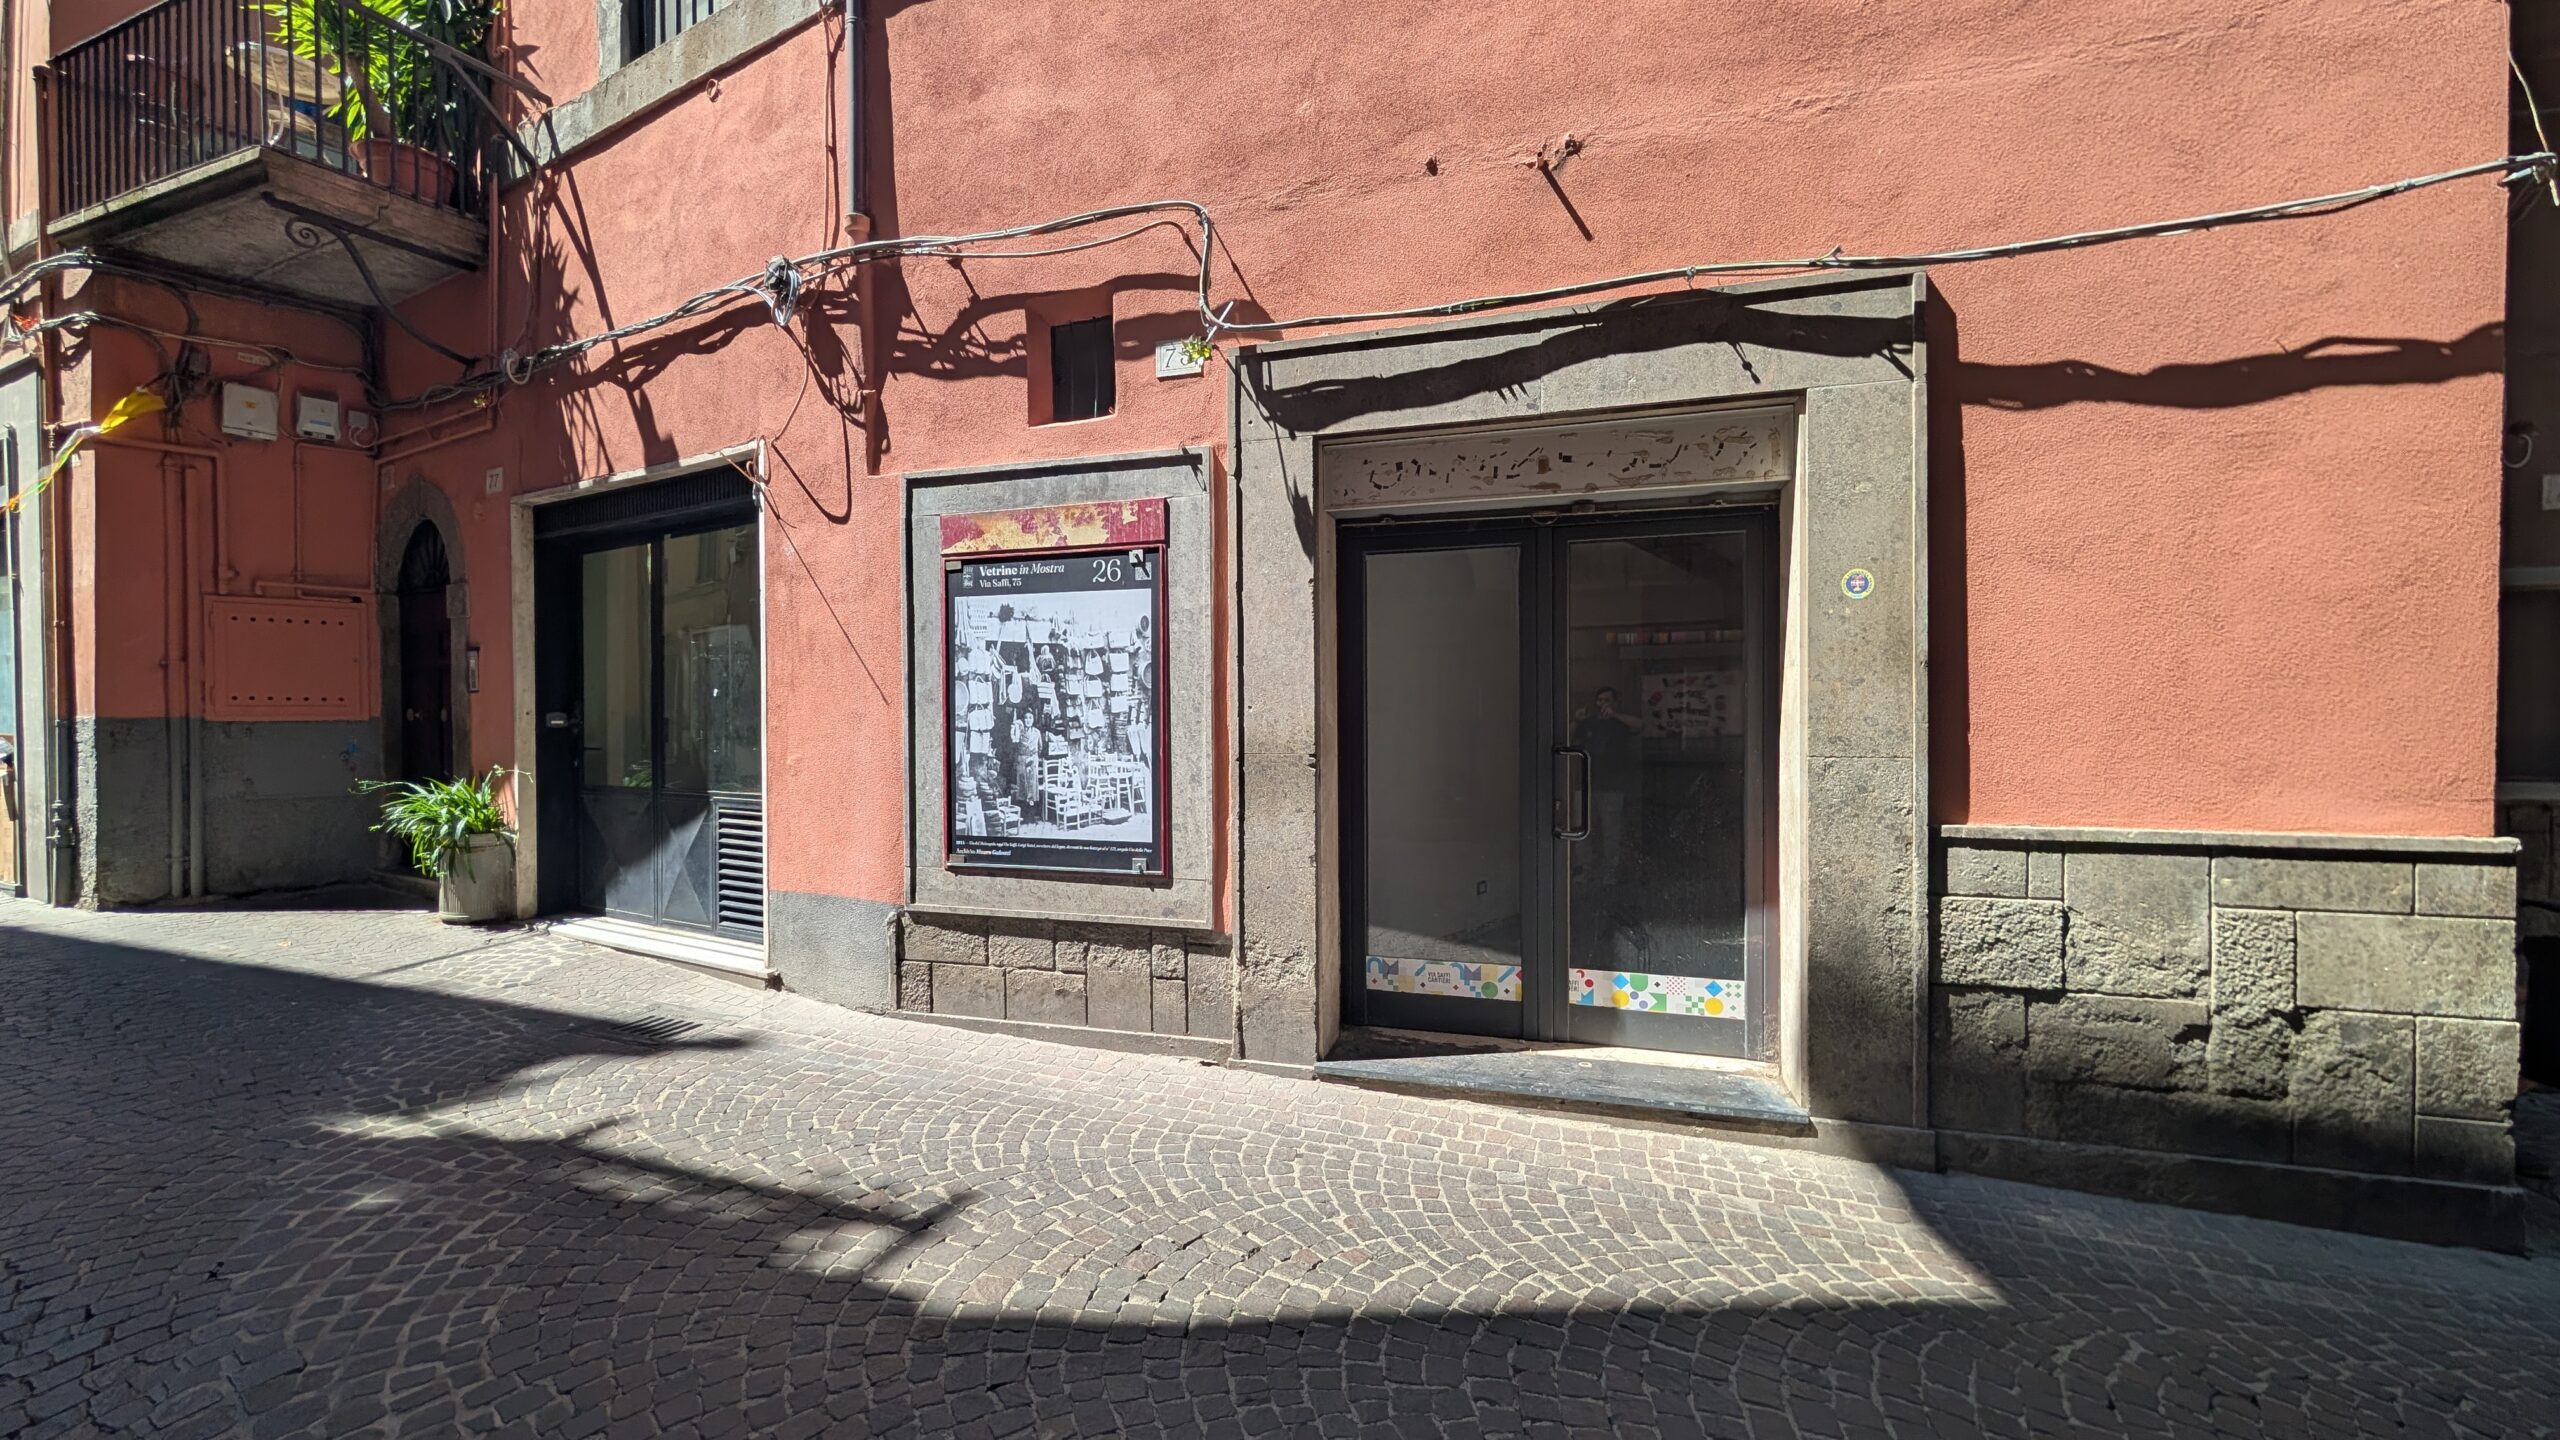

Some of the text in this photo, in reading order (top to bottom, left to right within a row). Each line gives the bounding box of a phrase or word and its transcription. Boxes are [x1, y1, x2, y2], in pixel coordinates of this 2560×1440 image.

[488, 473, 500, 489] 77
[979, 562, 1065, 577] Vetrine in Mostra
[1092, 558, 1122, 583] 26
[979, 579, 992, 588] Via
[1012, 577, 1022, 587] 75
